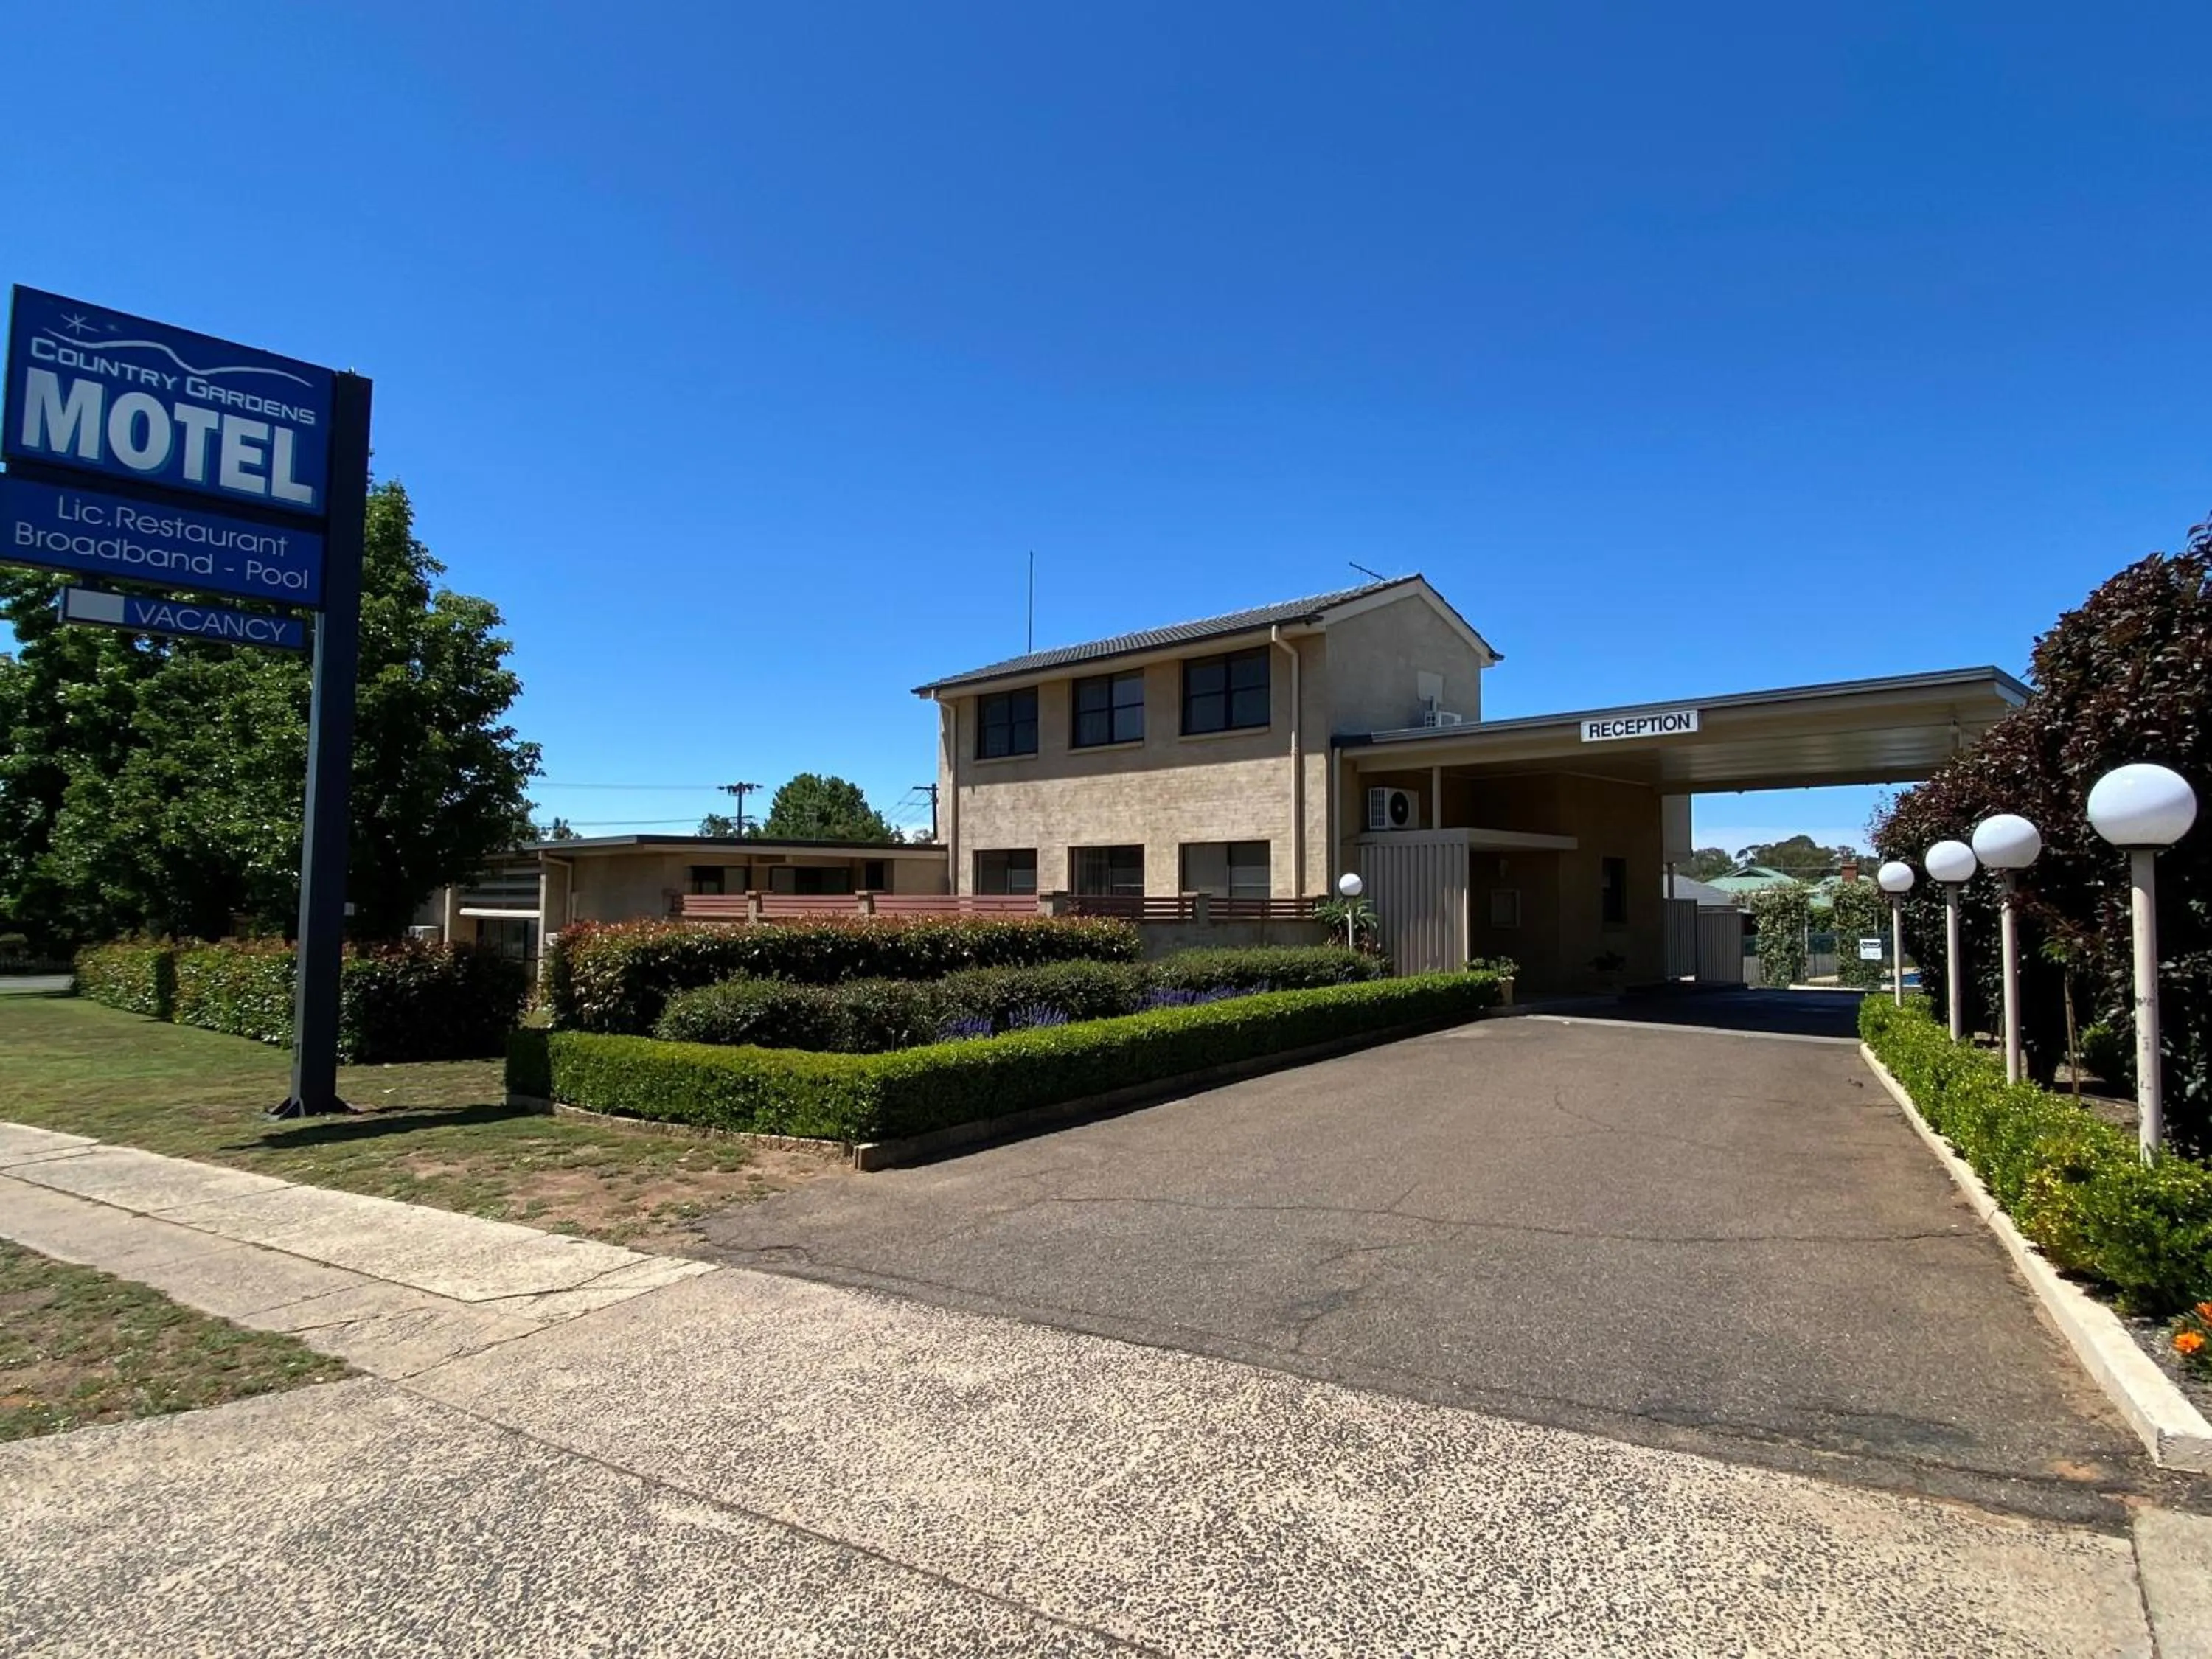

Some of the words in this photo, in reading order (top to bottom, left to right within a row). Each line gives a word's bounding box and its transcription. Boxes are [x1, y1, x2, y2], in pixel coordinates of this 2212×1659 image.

[31, 336, 178, 390] COUNTRY
[186, 376, 316, 425] GARDENS
[21, 367, 313, 504] MOTEL
[15, 521, 214, 575] Broadband
[246, 560, 309, 591] Pool
[135, 601, 288, 642] VACANCY
[1589, 713, 1691, 738] RECEPTION
